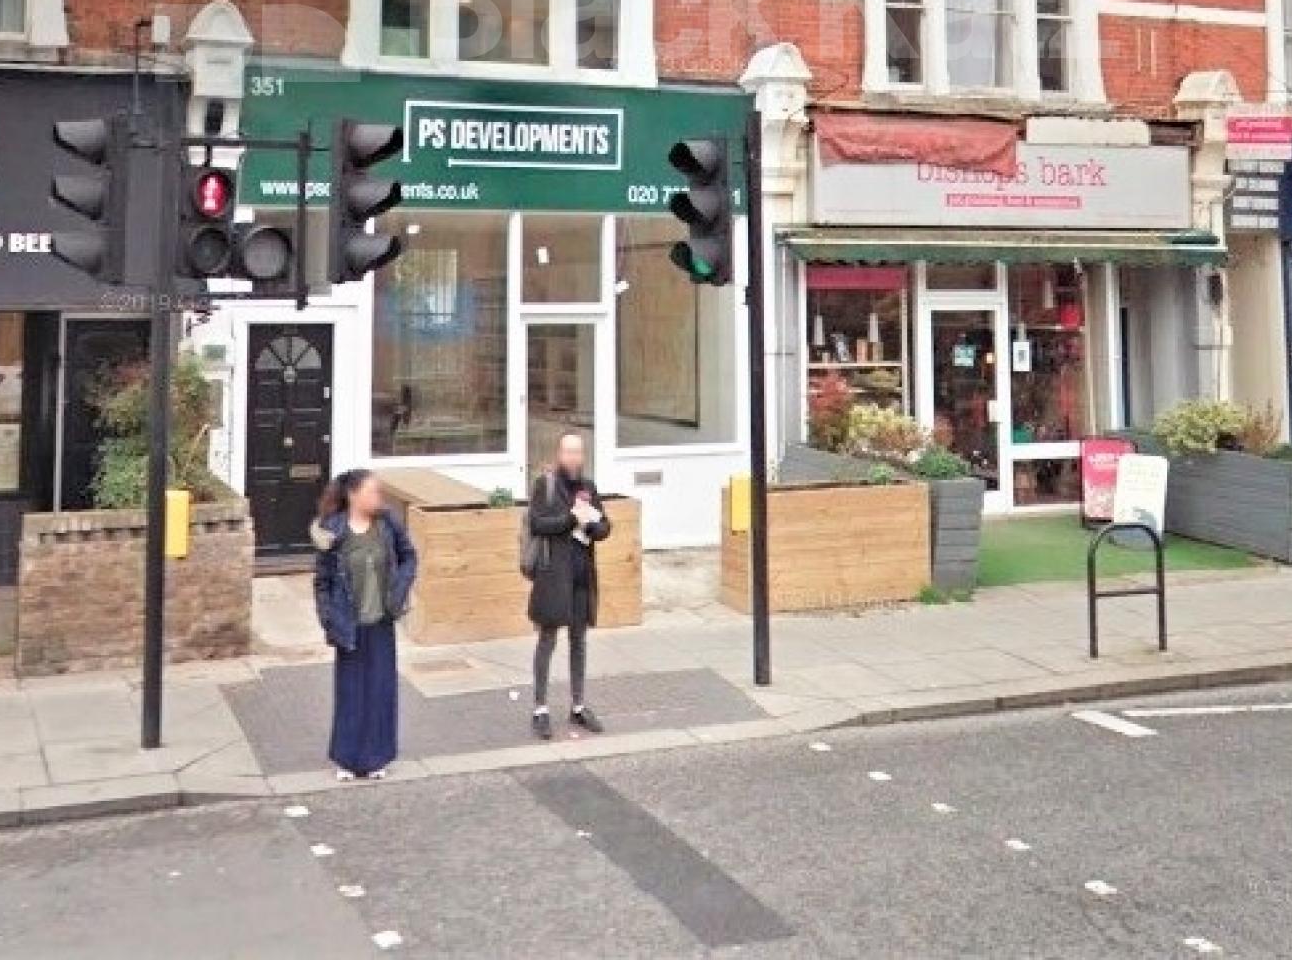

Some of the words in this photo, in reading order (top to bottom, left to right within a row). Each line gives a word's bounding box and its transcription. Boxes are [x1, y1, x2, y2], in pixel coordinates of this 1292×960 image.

[250, 76, 285, 96] 351
[418, 119, 446, 149] PS
[450, 119, 610, 155] DEVELOPMENTS
[1037, 156, 1108, 187] bark
[628, 185, 659, 204] 020
[8, 233, 53, 253] BEE
